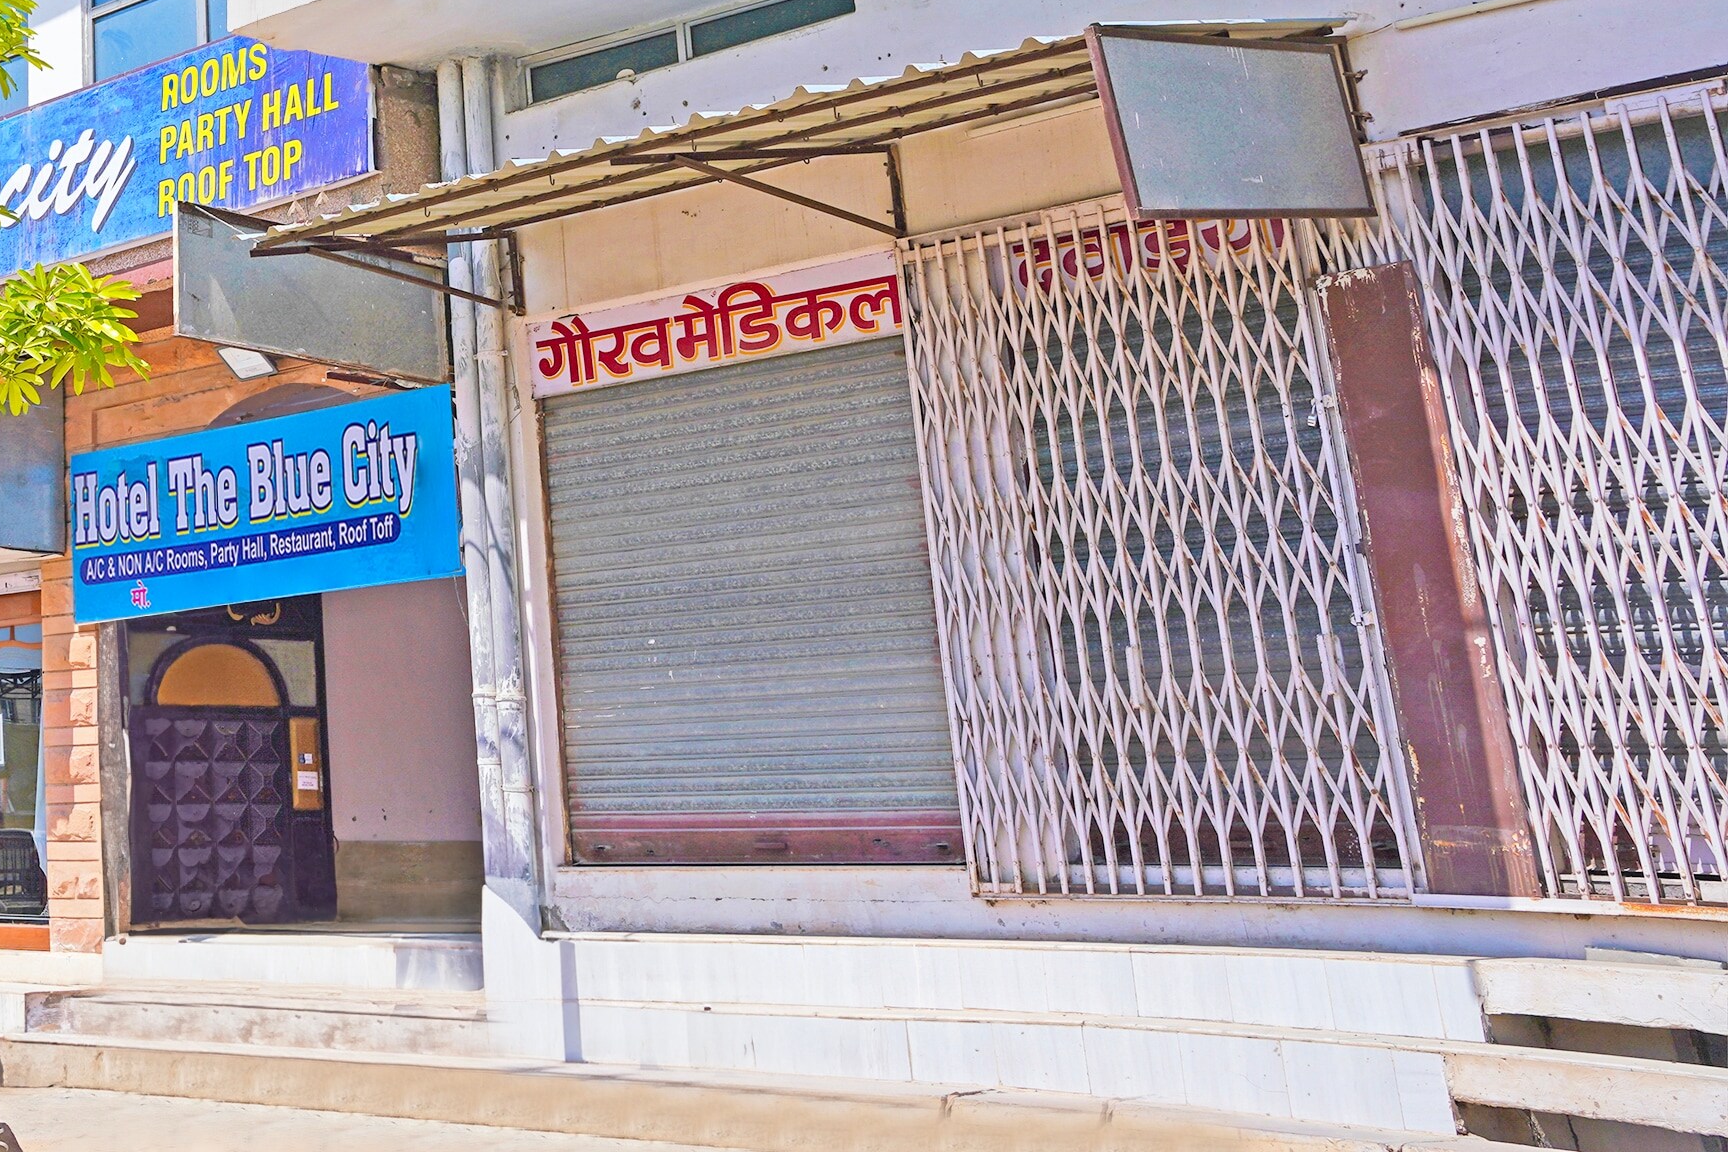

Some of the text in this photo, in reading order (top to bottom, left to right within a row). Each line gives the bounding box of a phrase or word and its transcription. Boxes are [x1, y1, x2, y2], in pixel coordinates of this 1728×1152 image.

[159, 72, 340, 165] PARTY HALL
[161, 43, 268, 112] ROOMS
[158, 139, 304, 218] ROOF TOP
[536, 281, 903, 386] गौरव मेडिकल
[74, 419, 418, 548] Hotel The Blue City
[86, 517, 395, 581] A/C & NON A/C Rooms, Party Hall, Restaurant, Roof Toff
